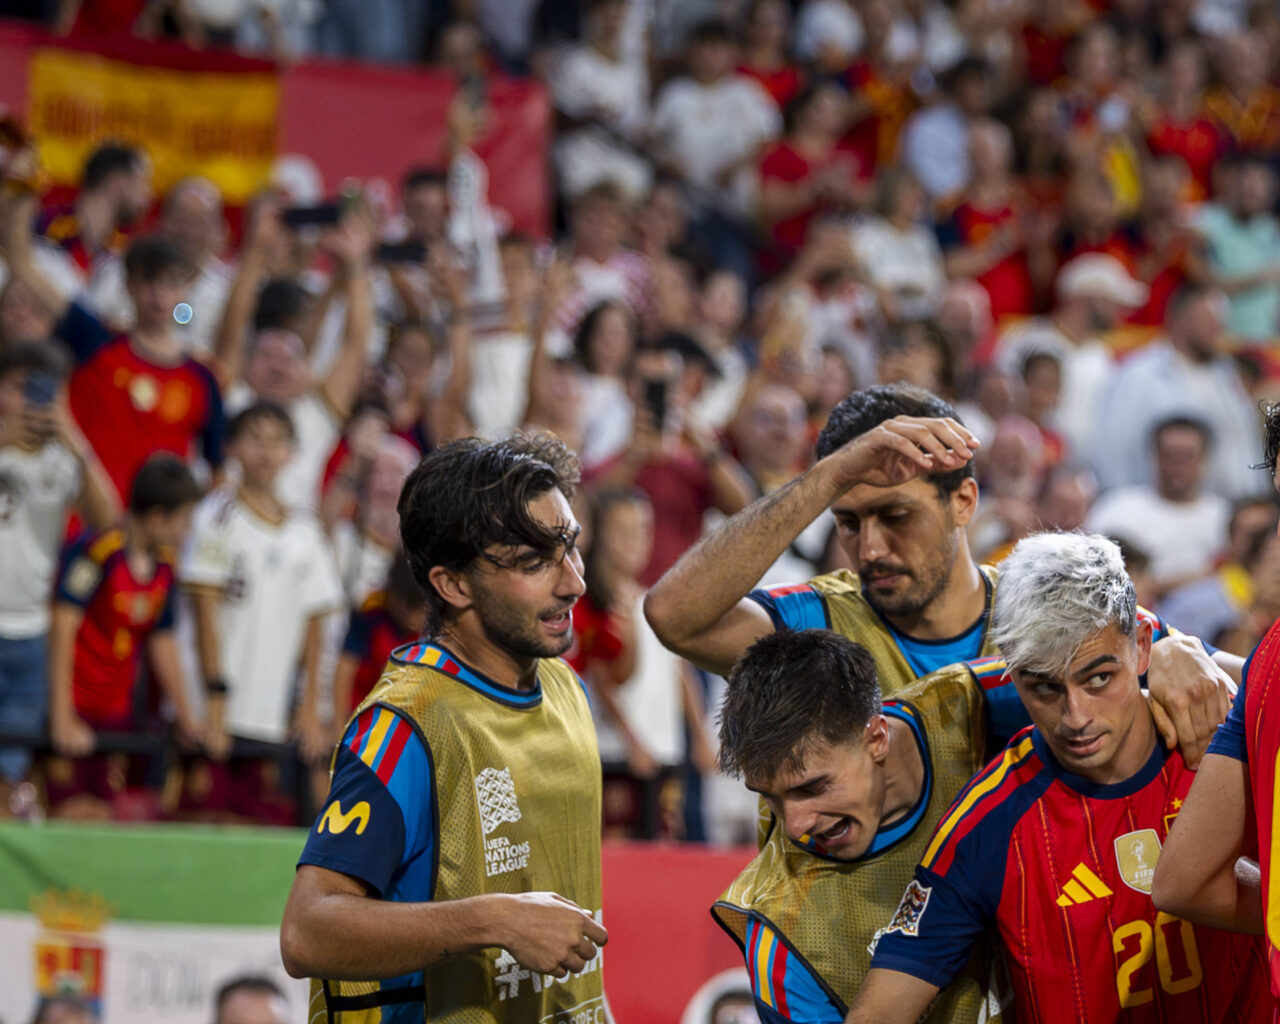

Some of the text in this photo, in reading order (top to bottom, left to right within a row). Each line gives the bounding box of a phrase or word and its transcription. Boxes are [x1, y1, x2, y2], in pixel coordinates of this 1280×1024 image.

[485, 841, 531, 863] NATIONS
[487, 837, 510, 850] UEFA
[486, 857, 529, 877] LEAGUE
[1112, 910, 1203, 1009] 20
